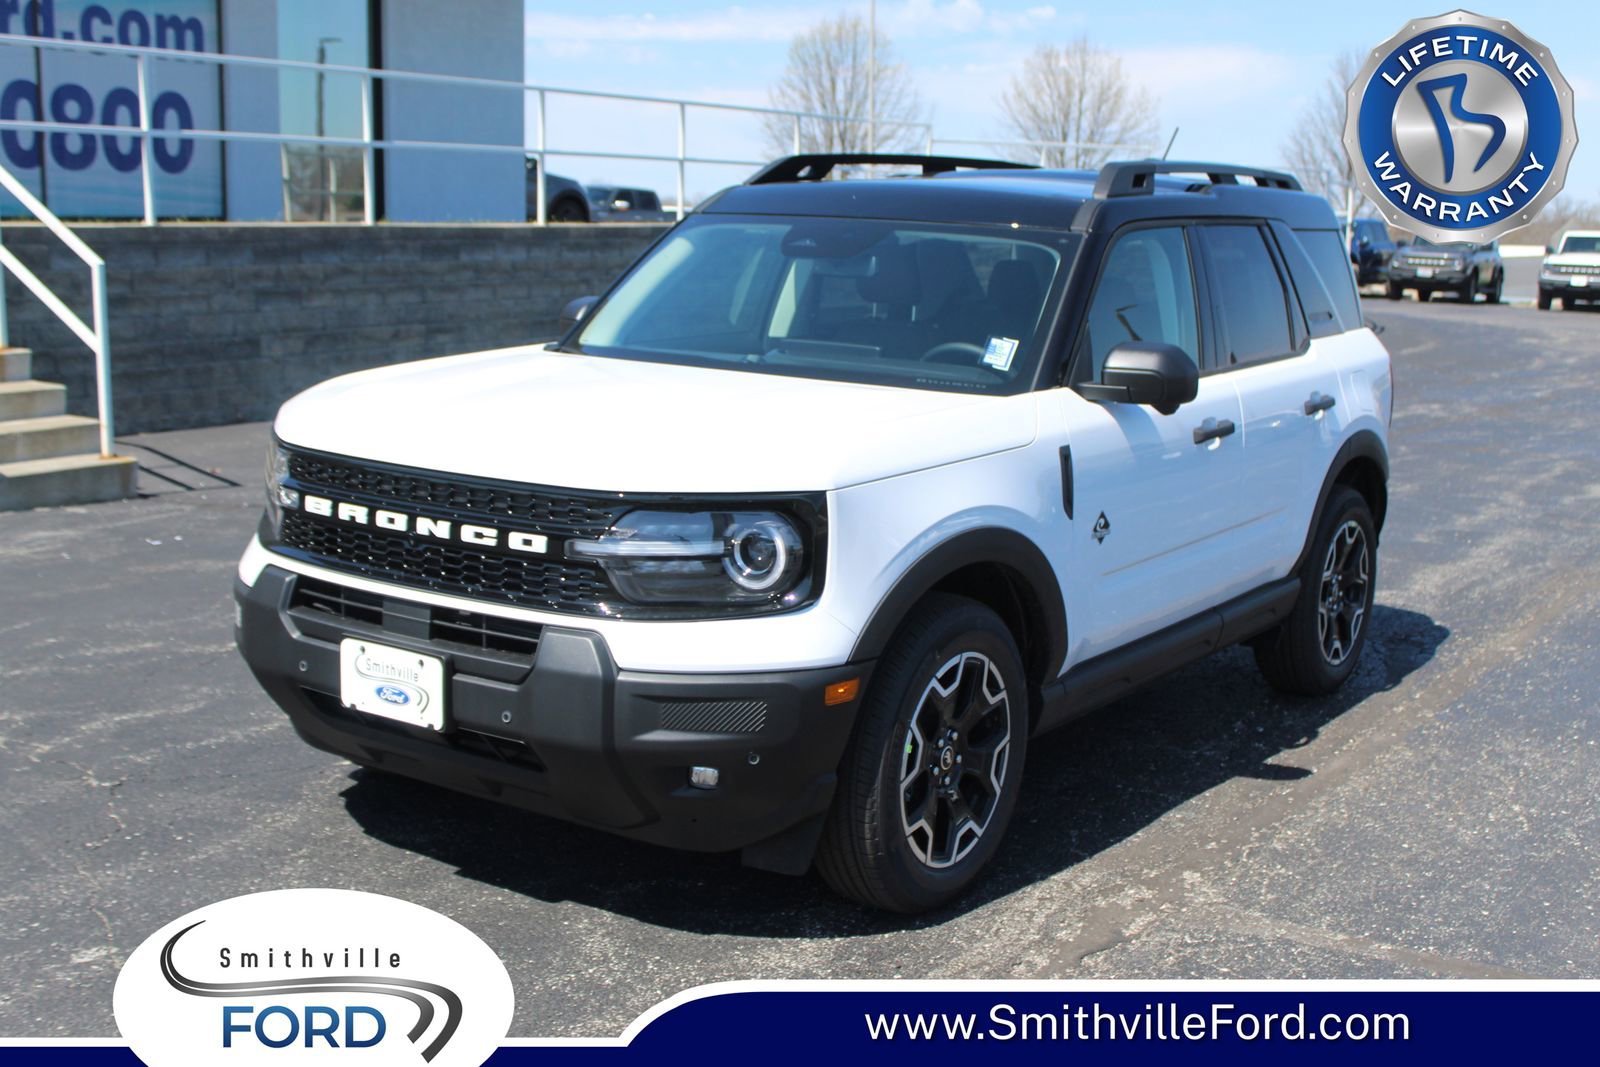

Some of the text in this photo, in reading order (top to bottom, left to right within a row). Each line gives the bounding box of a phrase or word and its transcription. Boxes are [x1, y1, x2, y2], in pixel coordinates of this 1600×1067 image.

[1, 79, 194, 175] 0800
[304, 494, 548, 554] BRONCO
[366, 658, 420, 683] Smithville
[379, 686, 407, 705] Ford
